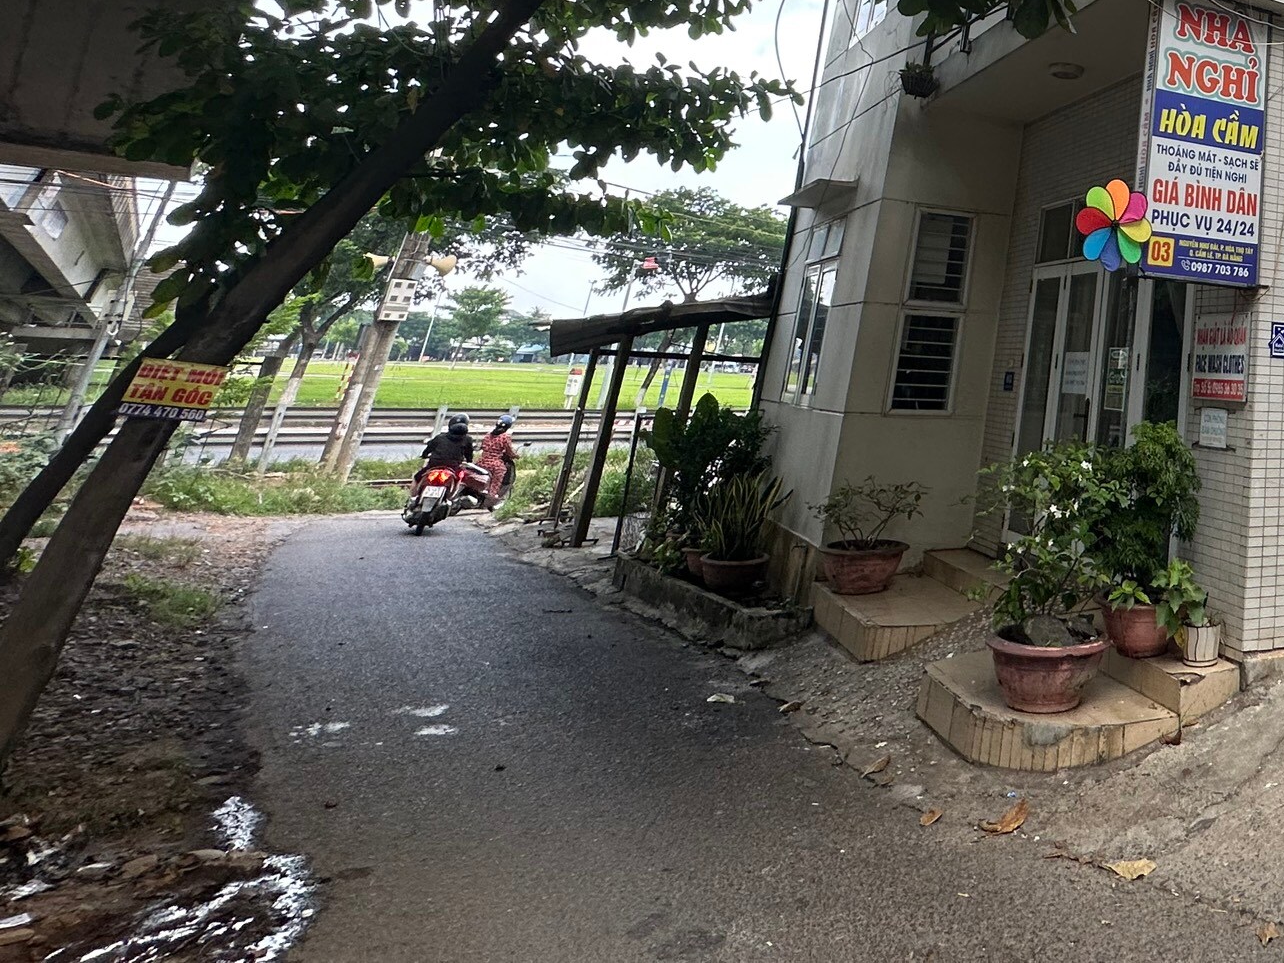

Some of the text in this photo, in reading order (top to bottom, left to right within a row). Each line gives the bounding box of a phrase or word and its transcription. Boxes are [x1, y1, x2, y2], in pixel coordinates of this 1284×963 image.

[1166, 50, 1260, 104] NGHỈ
[1159, 103, 1259, 149] HÒA CẦM
[1156, 143, 1196, 160] THOÁNG
[1198, 150, 1217, 164] MÁT
[1223, 155, 1248, 169] SẠCH
[1205, 166, 1223, 181] TIỆN
[1224, 171, 1247, 184] NGHI
[1152, 176, 1257, 217] GIÁ BÌNH DÂN
[1151, 208, 1255, 237] PHỤC VỤ 24/24
[1151, 240, 1171, 262] 03
[1190, 261, 1249, 277] 0987 703 786
[129, 382, 214, 406] TẬN GỐC
[118, 402, 205, 420] 0774 470 560
